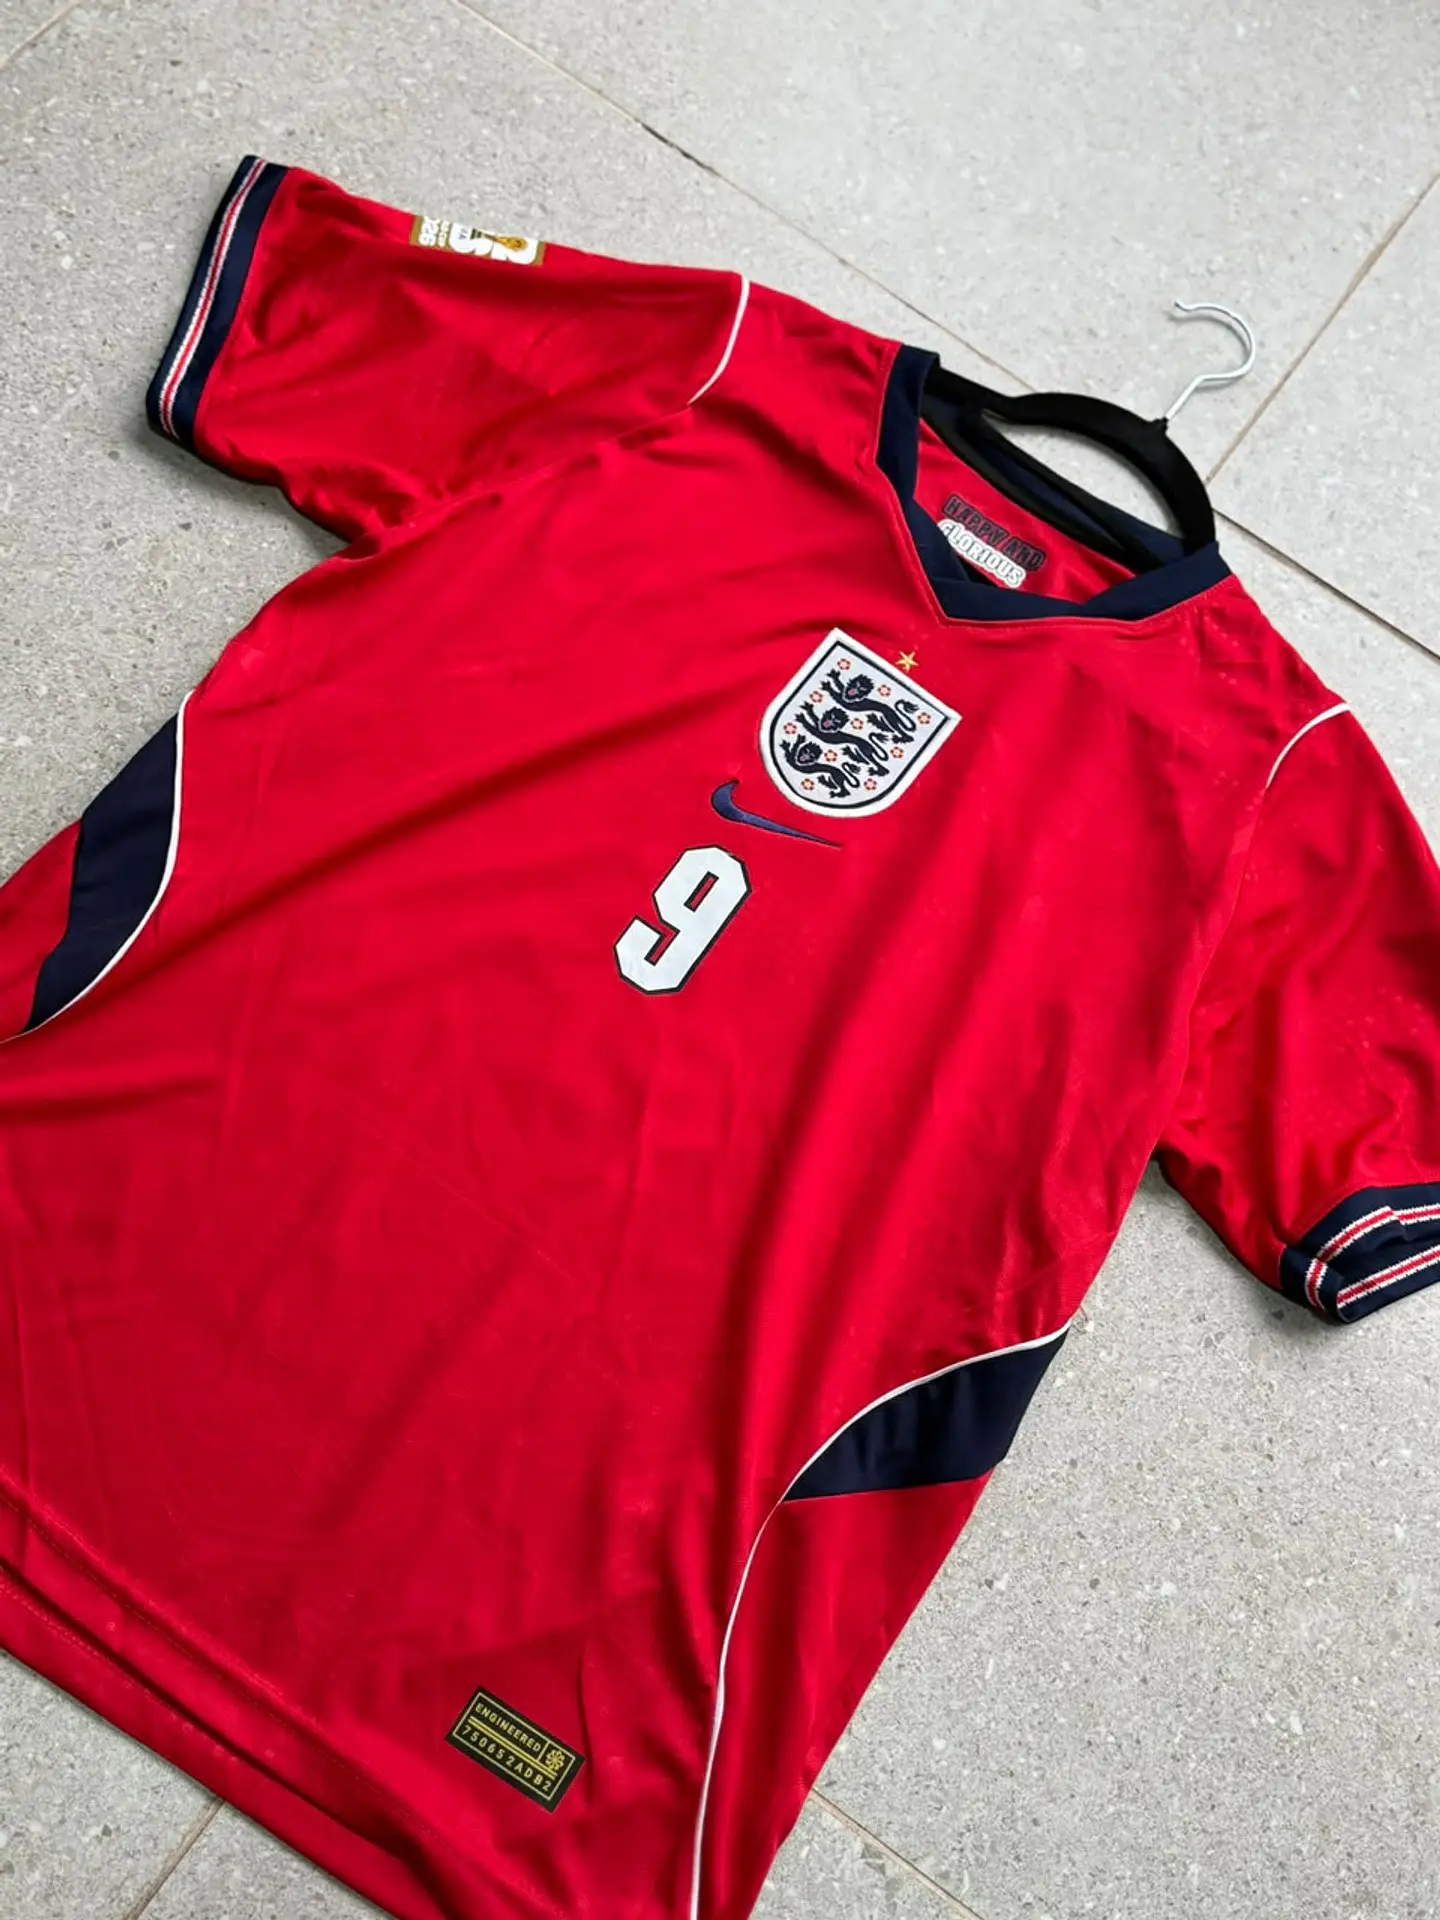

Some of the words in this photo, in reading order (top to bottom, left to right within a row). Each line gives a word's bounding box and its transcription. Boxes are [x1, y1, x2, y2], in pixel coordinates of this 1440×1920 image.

[944, 496, 1009, 548] HAPPY
[1003, 538, 1047, 571] AND
[614, 845, 752, 994] 9
[475, 1702, 542, 1752] ENGINEERED
